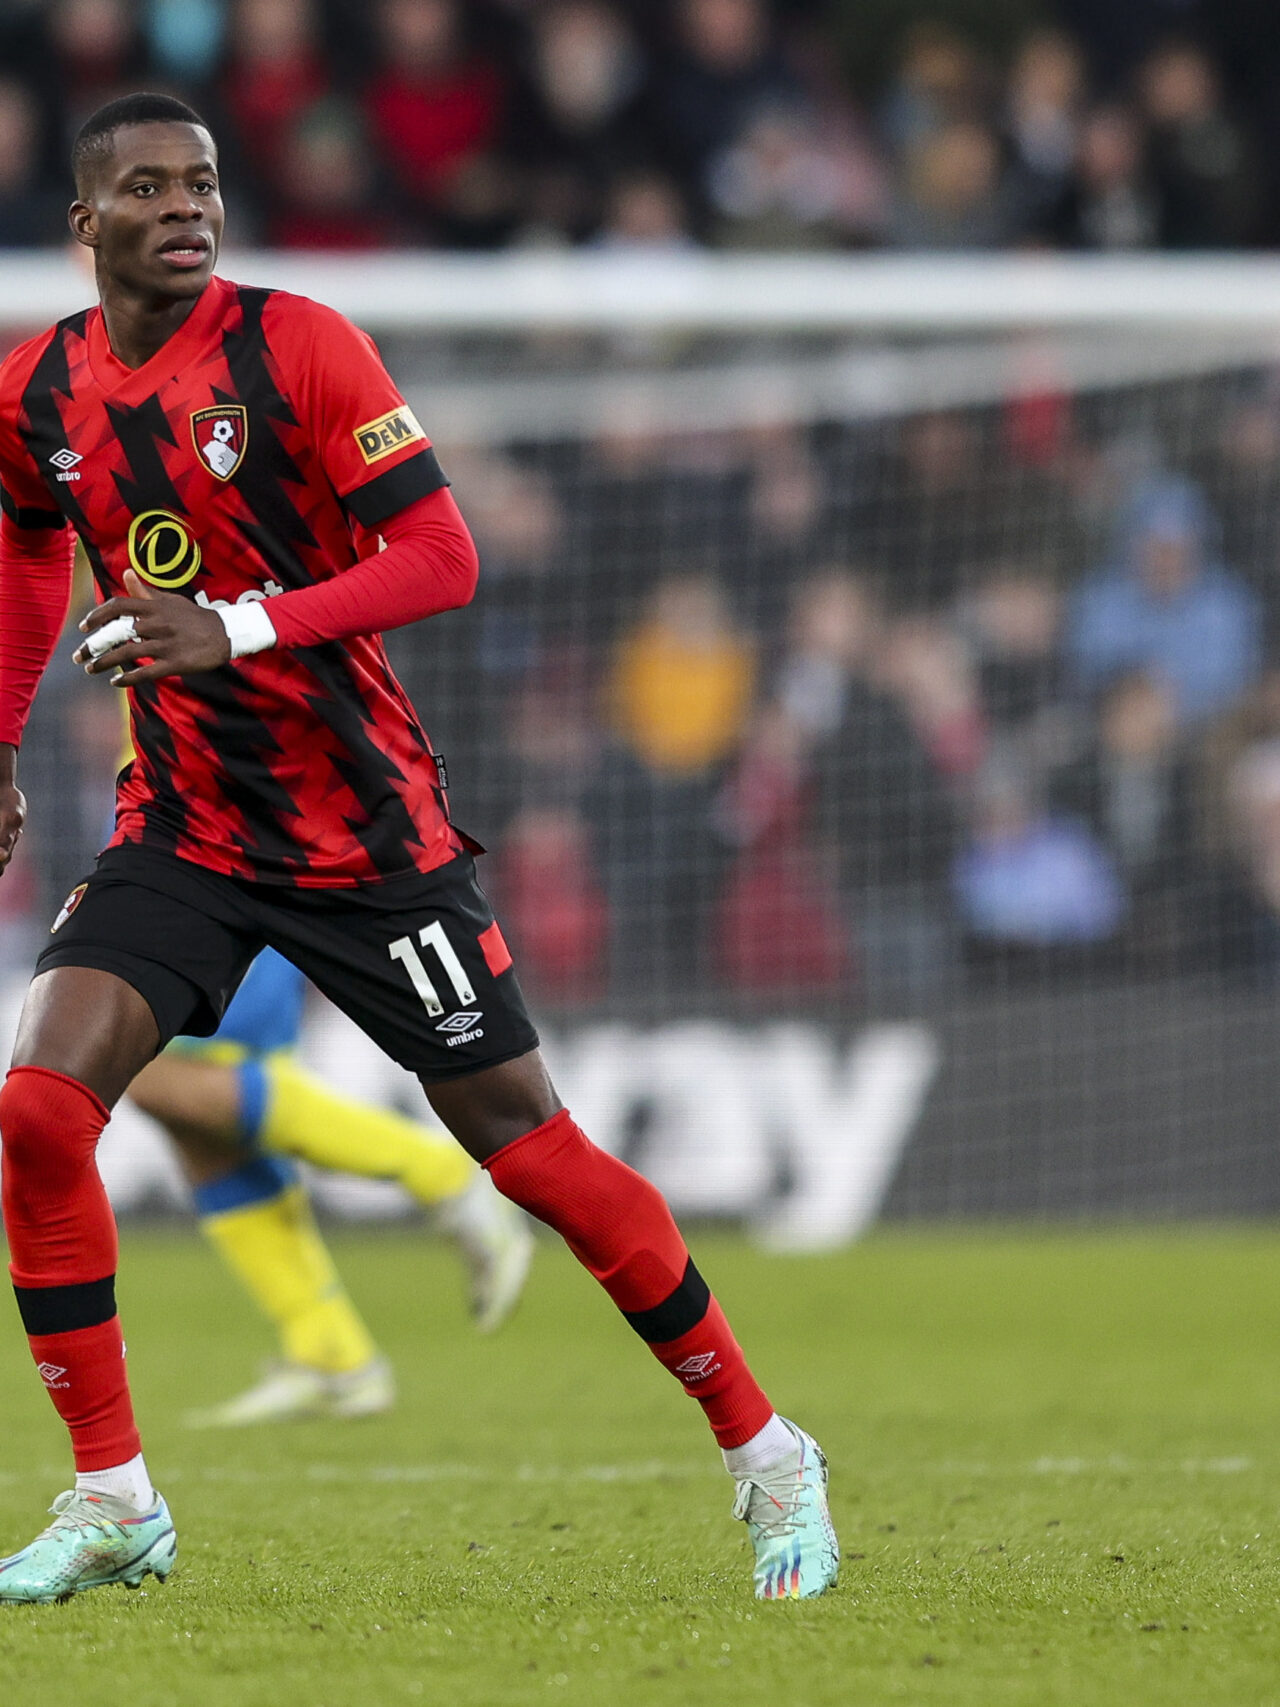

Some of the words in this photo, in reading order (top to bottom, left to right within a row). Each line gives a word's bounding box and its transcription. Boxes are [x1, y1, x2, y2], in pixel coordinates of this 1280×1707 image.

[55, 470, 81, 482] umbro
[388, 920, 477, 1017] 11
[445, 1028, 484, 1047] umbro
